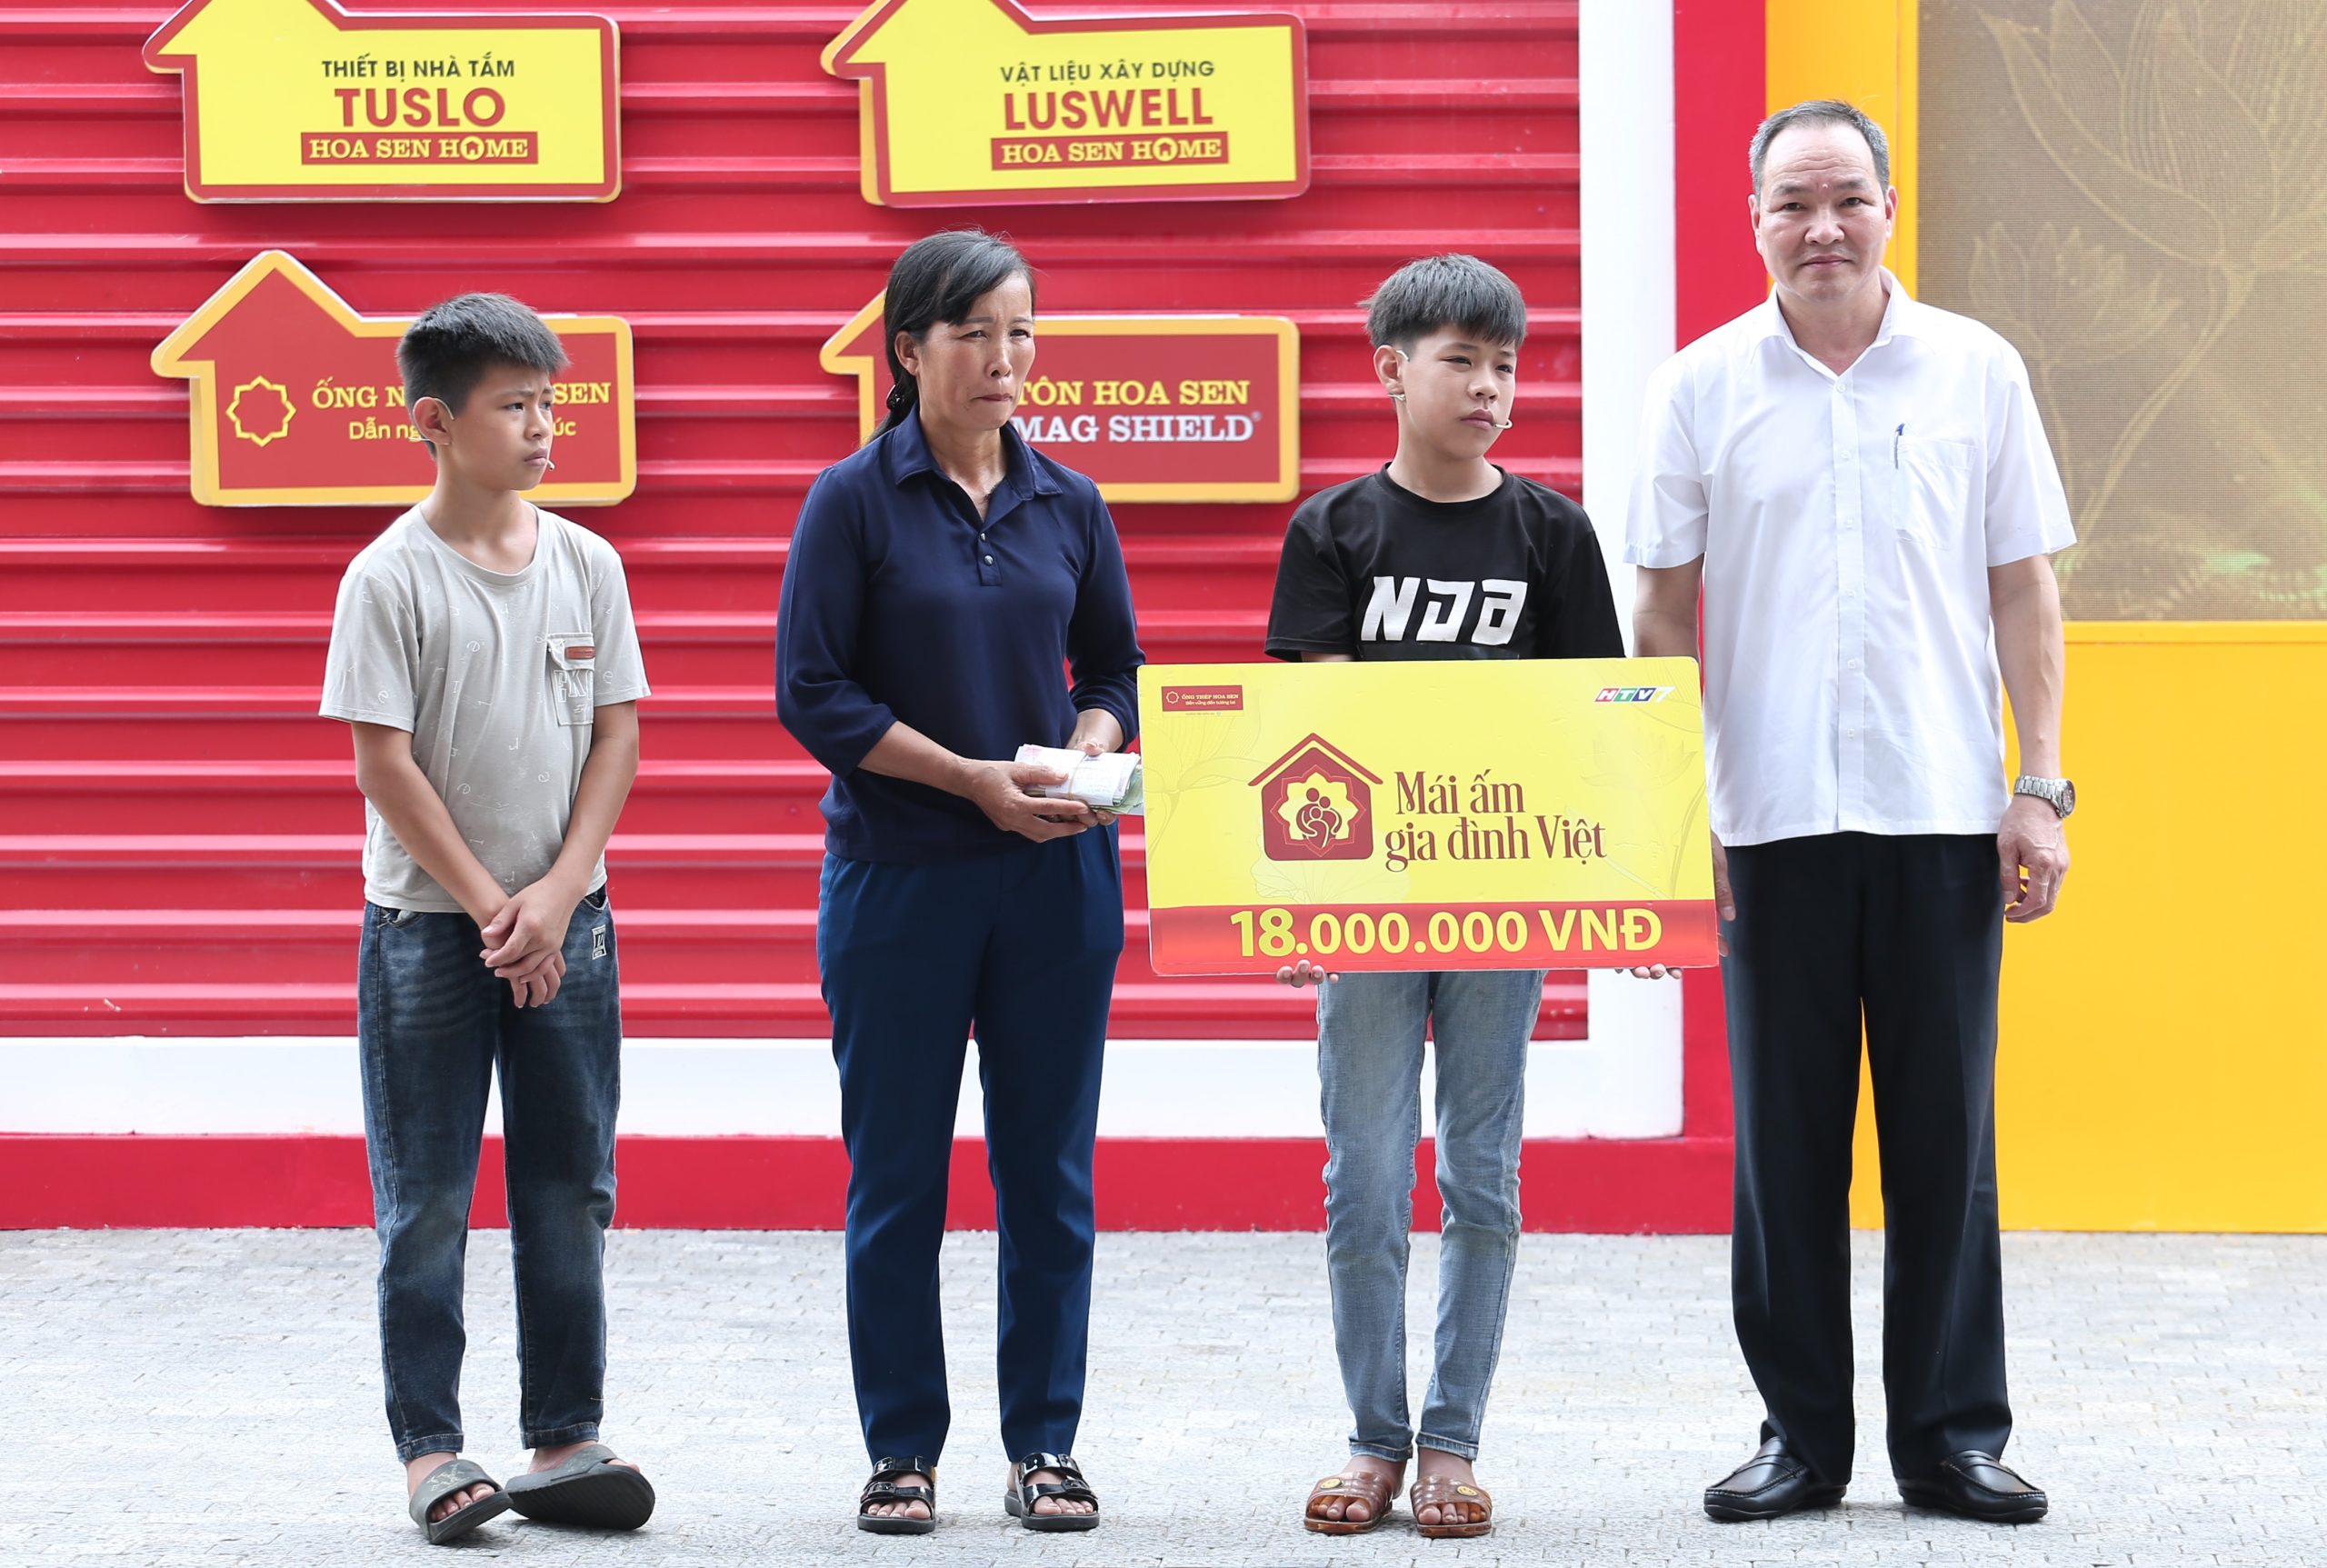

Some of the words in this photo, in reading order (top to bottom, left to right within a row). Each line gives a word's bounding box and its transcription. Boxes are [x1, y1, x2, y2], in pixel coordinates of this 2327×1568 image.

[322, 52, 378, 77] THIẾT
[385, 60, 405, 83] BỊ
[414, 55, 462, 77] NHÀ
[468, 52, 515, 77] TẮM
[1000, 62, 1042, 86] VẬT
[1049, 60, 1091, 85] LIỆU
[1100, 59, 1144, 79] XÂY
[1152, 59, 1215, 83] DỰNG
[334, 86, 506, 127] TUSLO
[1004, 87, 1213, 131] LUSWELL
[309, 138, 370, 159] HOA
[375, 138, 432, 159] SEN
[1001, 143, 1063, 165] HOA
[1068, 140, 1125, 163] SEN
[312, 376, 378, 408] ỐNG
[553, 382, 612, 404] SEN
[1093, 380, 1171, 406] HOA
[1179, 380, 1251, 405] SEN
[348, 416, 391, 440] Dẫn
[1009, 414, 1100, 443] MAG
[1393, 770, 1460, 815] Mái
[1469, 768, 1526, 814] ấm
[1384, 822, 1438, 873] gia
[1447, 816, 1531, 861] đình
[1534, 814, 1608, 865] Việt
[1229, 907, 1529, 958] 18.000.000
[1538, 907, 1663, 952] VNĐ
